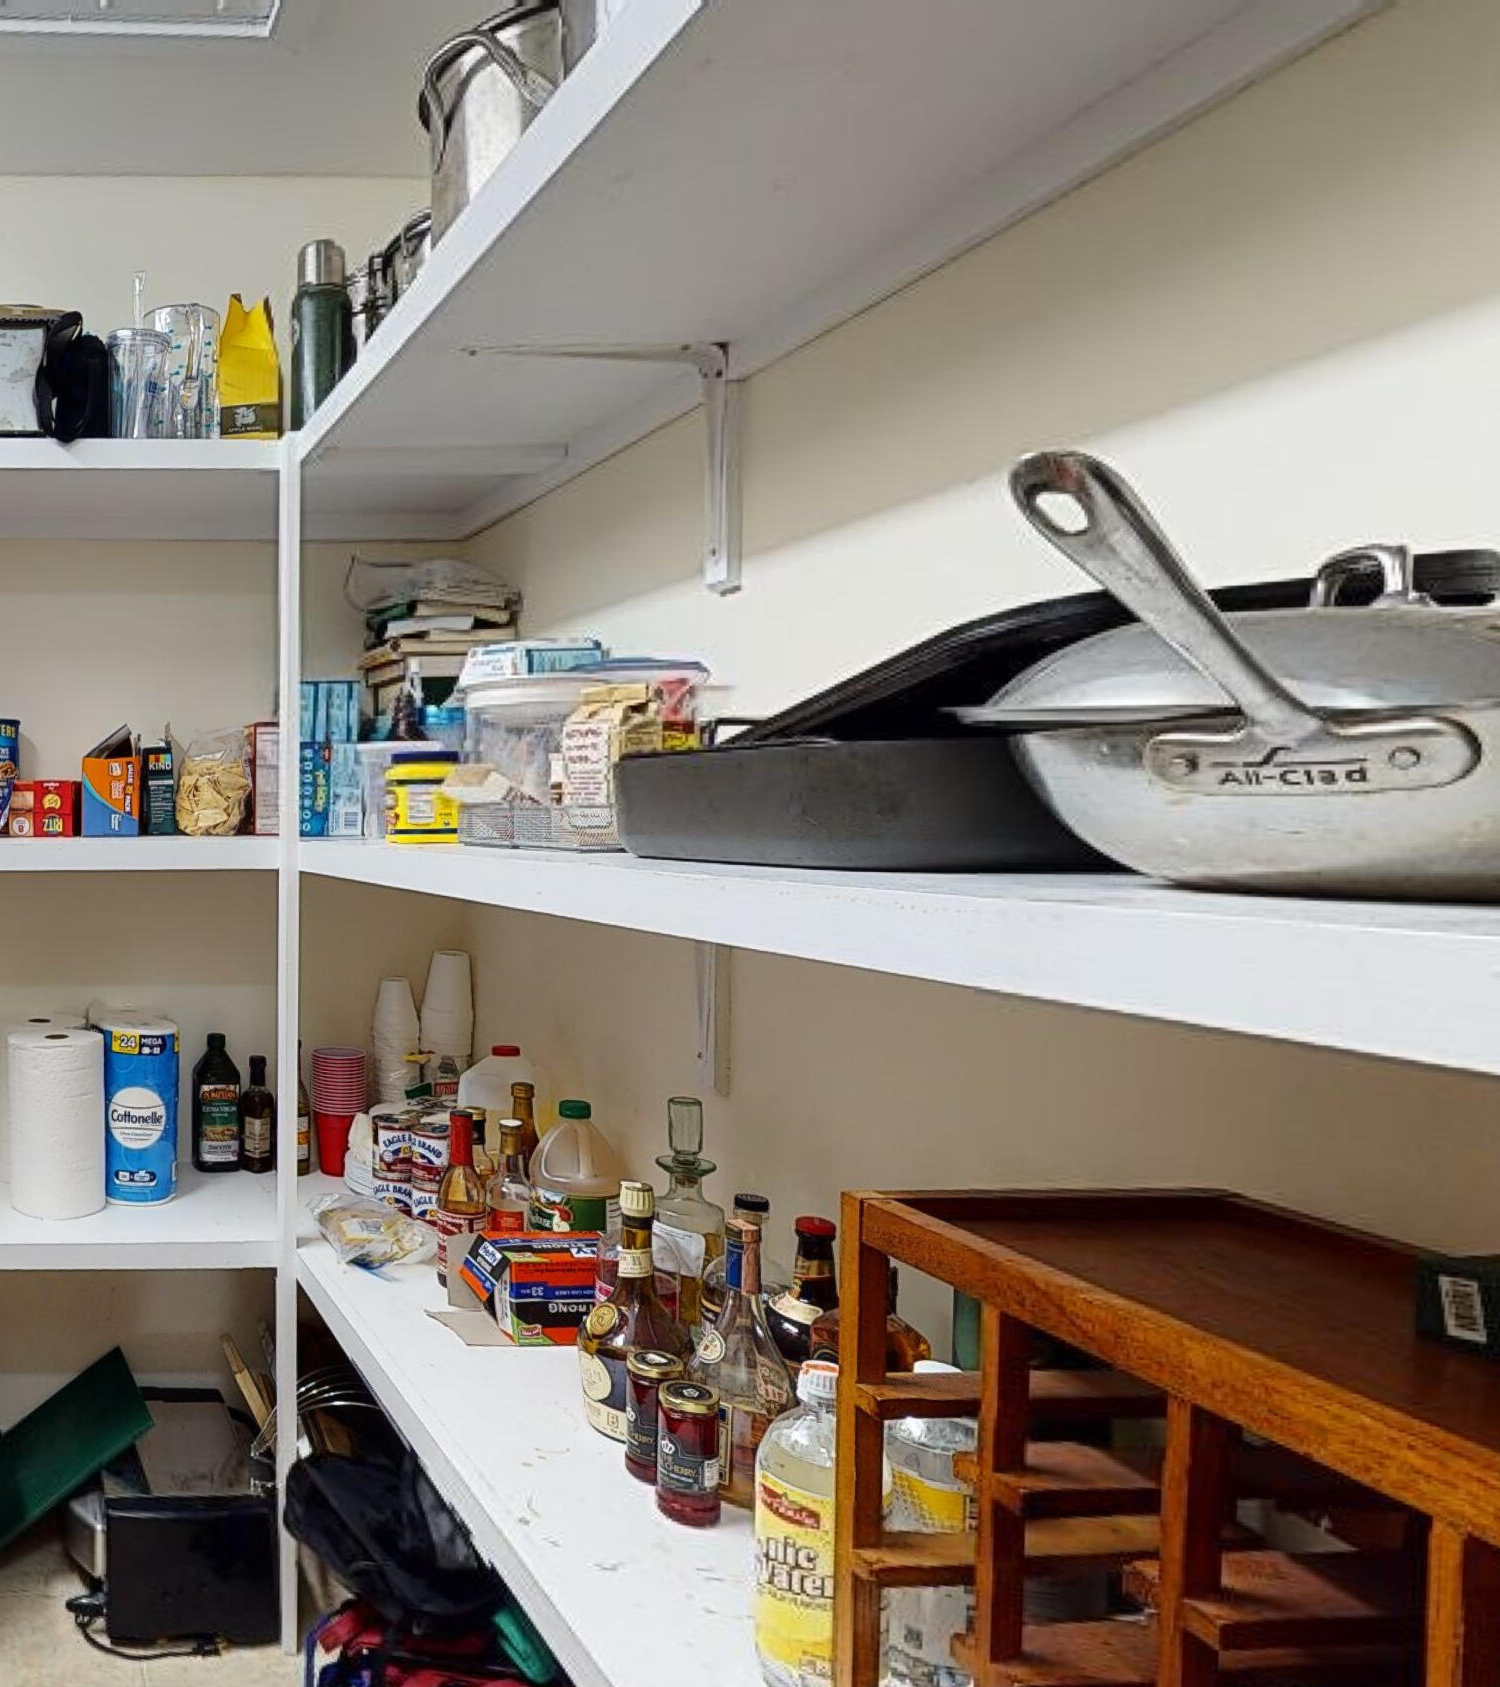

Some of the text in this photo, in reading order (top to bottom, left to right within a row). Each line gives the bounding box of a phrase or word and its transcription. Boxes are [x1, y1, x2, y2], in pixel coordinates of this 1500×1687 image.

[149, 761, 172, 771] KIND
[1219, 765, 1367, 786] All-Clad
[42, 817, 63, 833] RITZ
[120, 1034, 136, 1049] 24
[111, 1109, 164, 1125] Cottonelle
[383, 1133, 407, 1148] EAGLE
[392, 1184, 413, 1200] BRAN
[479, 1241, 502, 1265] Hefty
[531, 1286, 545, 1296] 33
